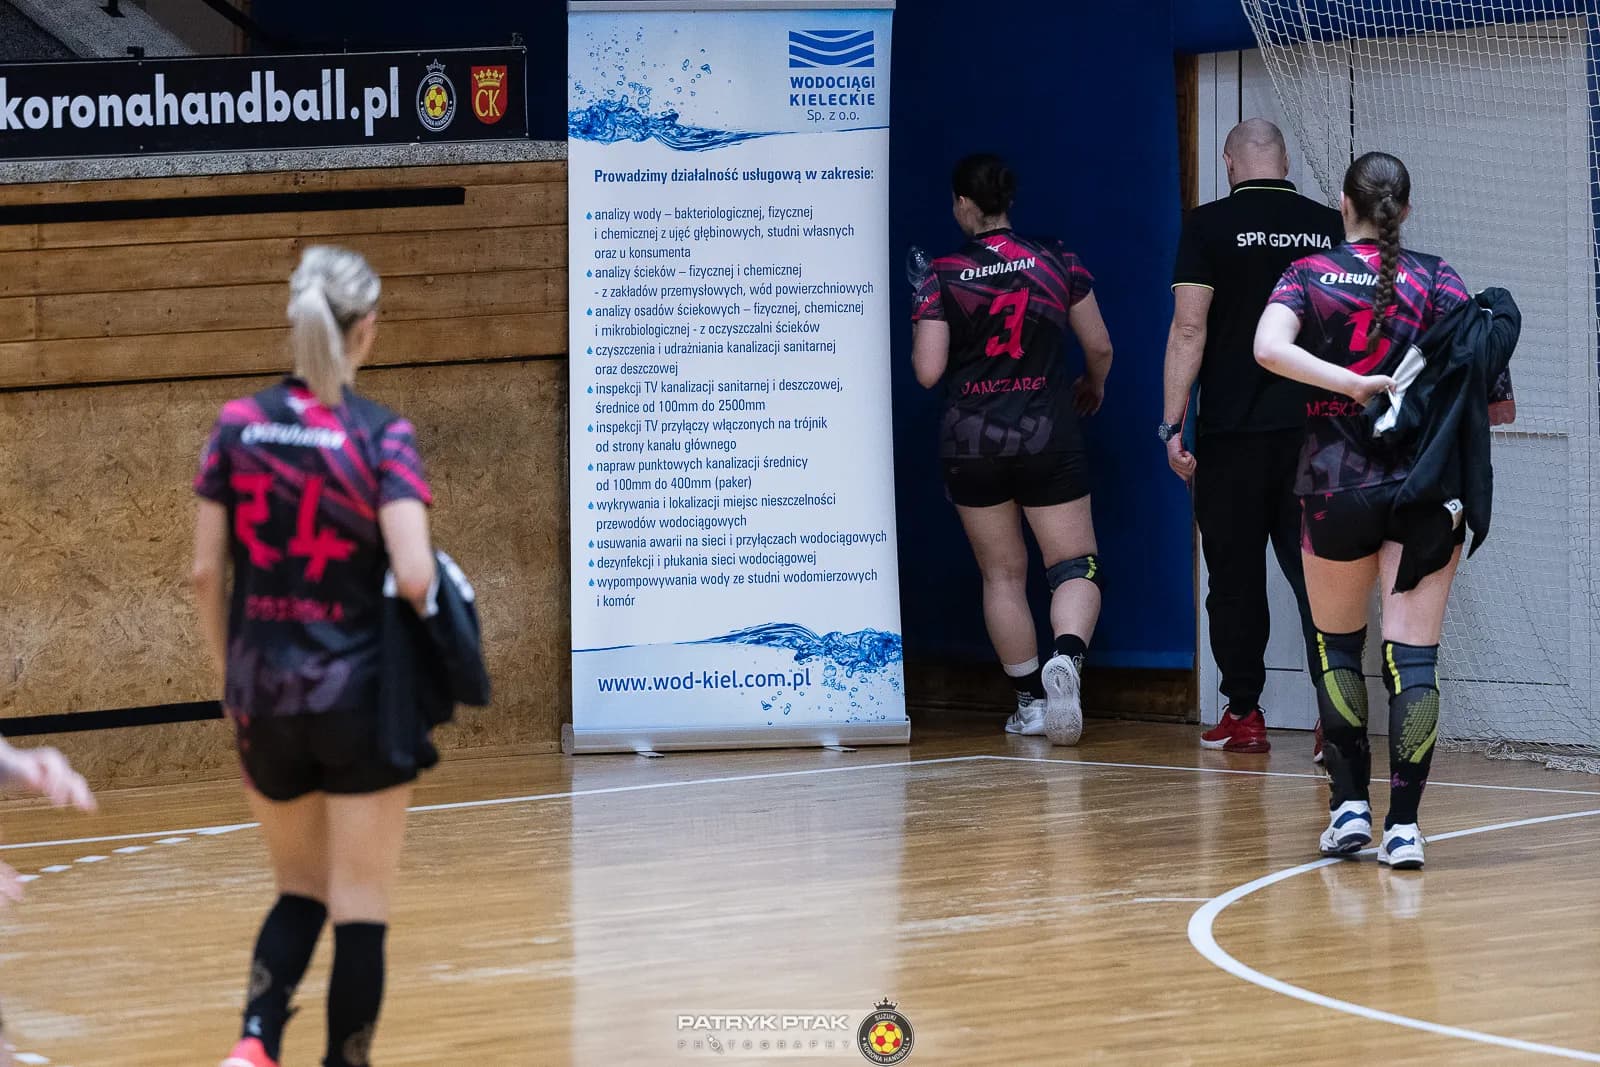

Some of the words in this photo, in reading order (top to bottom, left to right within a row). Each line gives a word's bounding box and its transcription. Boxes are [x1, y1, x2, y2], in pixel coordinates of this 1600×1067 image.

[789, 76, 875, 93] WODOCIĄGI
[0, 66, 400, 136] koronahandball.pl
[475, 89, 500, 117] CK
[789, 93, 875, 107] KIELECKIE
[807, 109, 825, 124] Sp.
[829, 111, 836, 121] z
[838, 111, 860, 121] o.o.
[594, 168, 668, 185] Prowadzimy
[671, 167, 739, 182] działalność
[742, 167, 802, 184] usługową
[804, 170, 818, 180] w
[820, 166, 874, 180] zakresie:
[594, 207, 631, 223] analizy
[633, 207, 662, 223] wody
[674, 205, 765, 222] bakteriologicznej,
[768, 205, 813, 221] fizycznej
[594, 227, 597, 240] i
[601, 226, 658, 242] chemicznej
[661, 229, 667, 239] z
[669, 225, 691, 242] ujęć
[693, 224, 764, 242] głębinowych,
[767, 224, 800, 238] studni
[802, 224, 854, 239] własnych
[1237, 232, 1266, 247] SPR
[1269, 233, 1331, 249] GDYNIA
[594, 249, 617, 260] oraz
[619, 249, 626, 259] u
[629, 246, 691, 259] konsumenta
[594, 265, 631, 281] analizy
[633, 264, 676, 278] ścieków
[689, 264, 734, 280] fizycznej
[737, 263, 740, 277] i
[743, 263, 802, 278] chemicznej
[975, 257, 1036, 278] LEWIATAN
[1338, 271, 1407, 286] LEWIAN
[601, 288, 608, 298] z
[610, 284, 658, 298] zakładów
[660, 283, 746, 300] przemysłowych,
[749, 282, 773, 296] wód
[775, 281, 874, 298] powierzchniowych
[595, 304, 632, 320] analizy
[634, 303, 675, 317] osadów
[677, 302, 740, 318] ściekowych
[753, 301, 801, 317] fizycznej,
[804, 300, 864, 316] chemicznej
[595, 324, 598, 337] i
[601, 322, 690, 339] mikrobiologicznej
[699, 325, 706, 335] z
[708, 321, 773, 337] oczyszczalni
[775, 320, 820, 334] ścieków
[985, 288, 1025, 359] 3
[595, 342, 655, 359] czyszczenia
[658, 342, 661, 355] i
[664, 341, 724, 355] udrażniania
[727, 339, 780, 356] kanalizacji
[783, 339, 836, 355] sanitarnej
[595, 365, 618, 375] oraz
[620, 361, 678, 377] deszczowej
[595, 381, 642, 397] inspekcji
[643, 380, 658, 394] TV
[661, 379, 715, 395] kanalizacji
[717, 378, 769, 394] sanitarnej
[772, 378, 776, 391] i
[778, 377, 843, 393] deszczowej,
[595, 401, 640, 414] średnice
[642, 400, 655, 413] od
[659, 400, 699, 413] 100mm
[701, 399, 715, 412] do
[718, 398, 766, 412] 2500mm
[596, 419, 642, 436] inspekcji
[644, 419, 659, 432] TV
[712, 417, 775, 434] włączonych
[778, 420, 791, 430] na
[794, 416, 828, 432] trójnik
[595, 440, 609, 453] od
[612, 441, 645, 455] strony
[684, 437, 737, 454] głównego
[596, 462, 636, 475] napraw
[638, 457, 703, 474] punktowych
[706, 455, 760, 471] kanalizacji
[763, 455, 808, 470] średnicy
[596, 478, 610, 492] od
[613, 478, 652, 491] 100mm
[654, 477, 668, 490] do
[670, 476, 712, 490] 400mm
[715, 475, 752, 491] (paker)
[596, 496, 660, 513] wykrywania
[663, 496, 666, 509] i
[669, 495, 720, 511] lokalizacji
[723, 494, 758, 510] miejsc
[761, 492, 836, 507] nieszczelności
[596, 516, 656, 533] przewodów
[658, 514, 747, 531] wodociągowych
[597, 535, 647, 550] usuwania
[649, 534, 682, 548] awarii
[685, 537, 698, 547] na
[701, 533, 726, 547] sieci
[729, 533, 733, 546] i
[799, 530, 887, 547] wodociągowych
[597, 554, 654, 571] dezynfekcji
[657, 554, 661, 567] i
[663, 553, 708, 570] płukania
[711, 552, 736, 566] sieci
[738, 550, 816, 567] wodociągowej
[596, 573, 697, 591] wypompowywania
[700, 572, 730, 588] wody
[733, 574, 745, 584] ze
[747, 570, 780, 584] studni
[783, 568, 878, 584] wodomierzowych
[597, 594, 600, 607] i
[603, 593, 636, 607] komór
[597, 667, 812, 692] www.wod-kiel.com.pl
